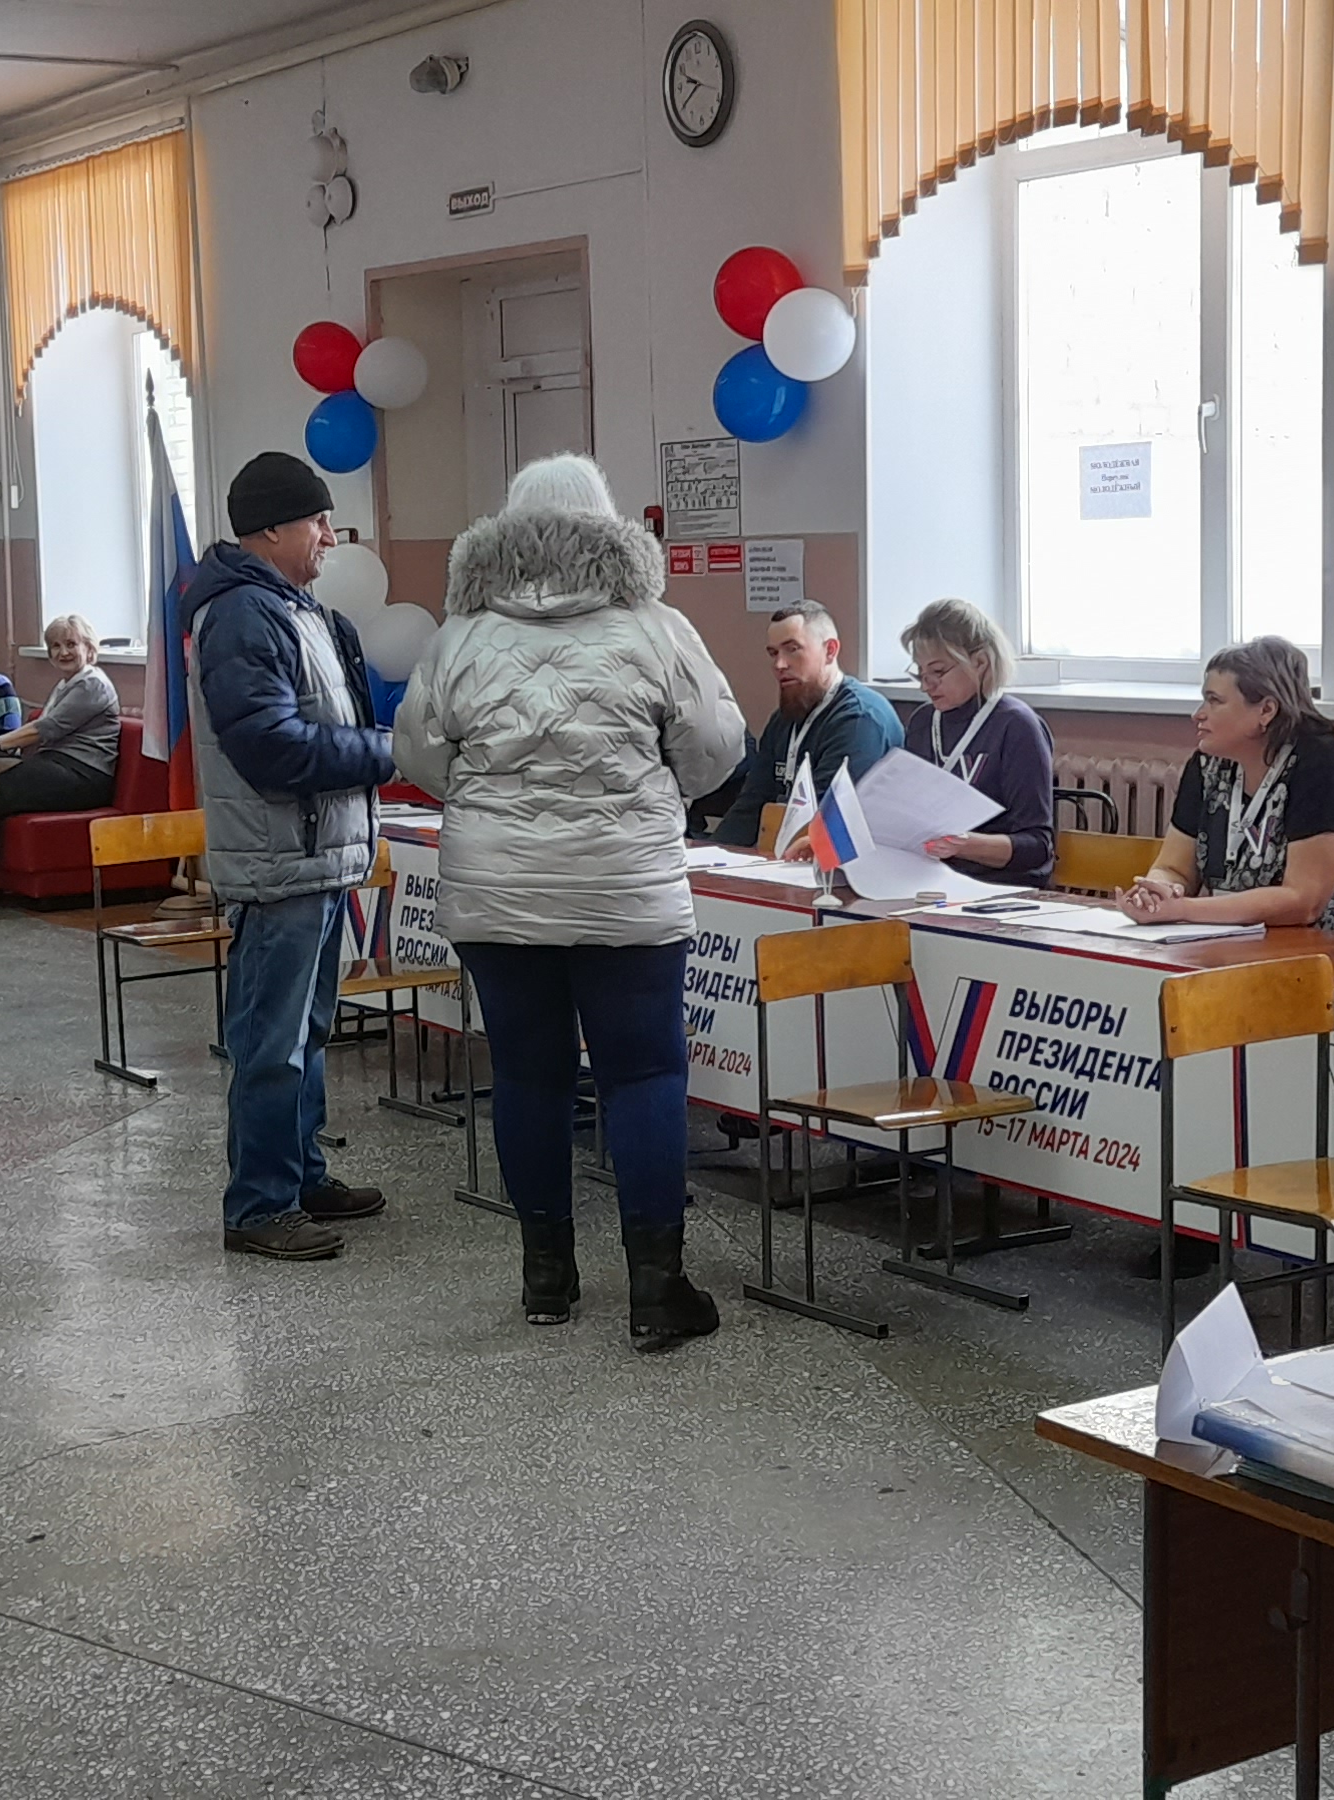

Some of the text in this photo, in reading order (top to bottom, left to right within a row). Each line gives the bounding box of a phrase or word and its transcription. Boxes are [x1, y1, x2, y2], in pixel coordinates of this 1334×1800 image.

[451, 192, 489, 210] ВЫХОД
[400, 905, 435, 932] ПРЕЗ
[395, 936, 448, 966] РОССИИ
[687, 930, 741, 964] БОРЫ
[684, 966, 759, 1007] ЗИДЕНТ
[1008, 988, 1128, 1037] ВЫБОРЫ
[718, 1048, 752, 1077] 2024
[996, 1029, 1161, 1092] ПРЕЗИДЕНТА
[1027, 1121, 1090, 1160] МАРТА
[1093, 1138, 1140, 1172] 2024
